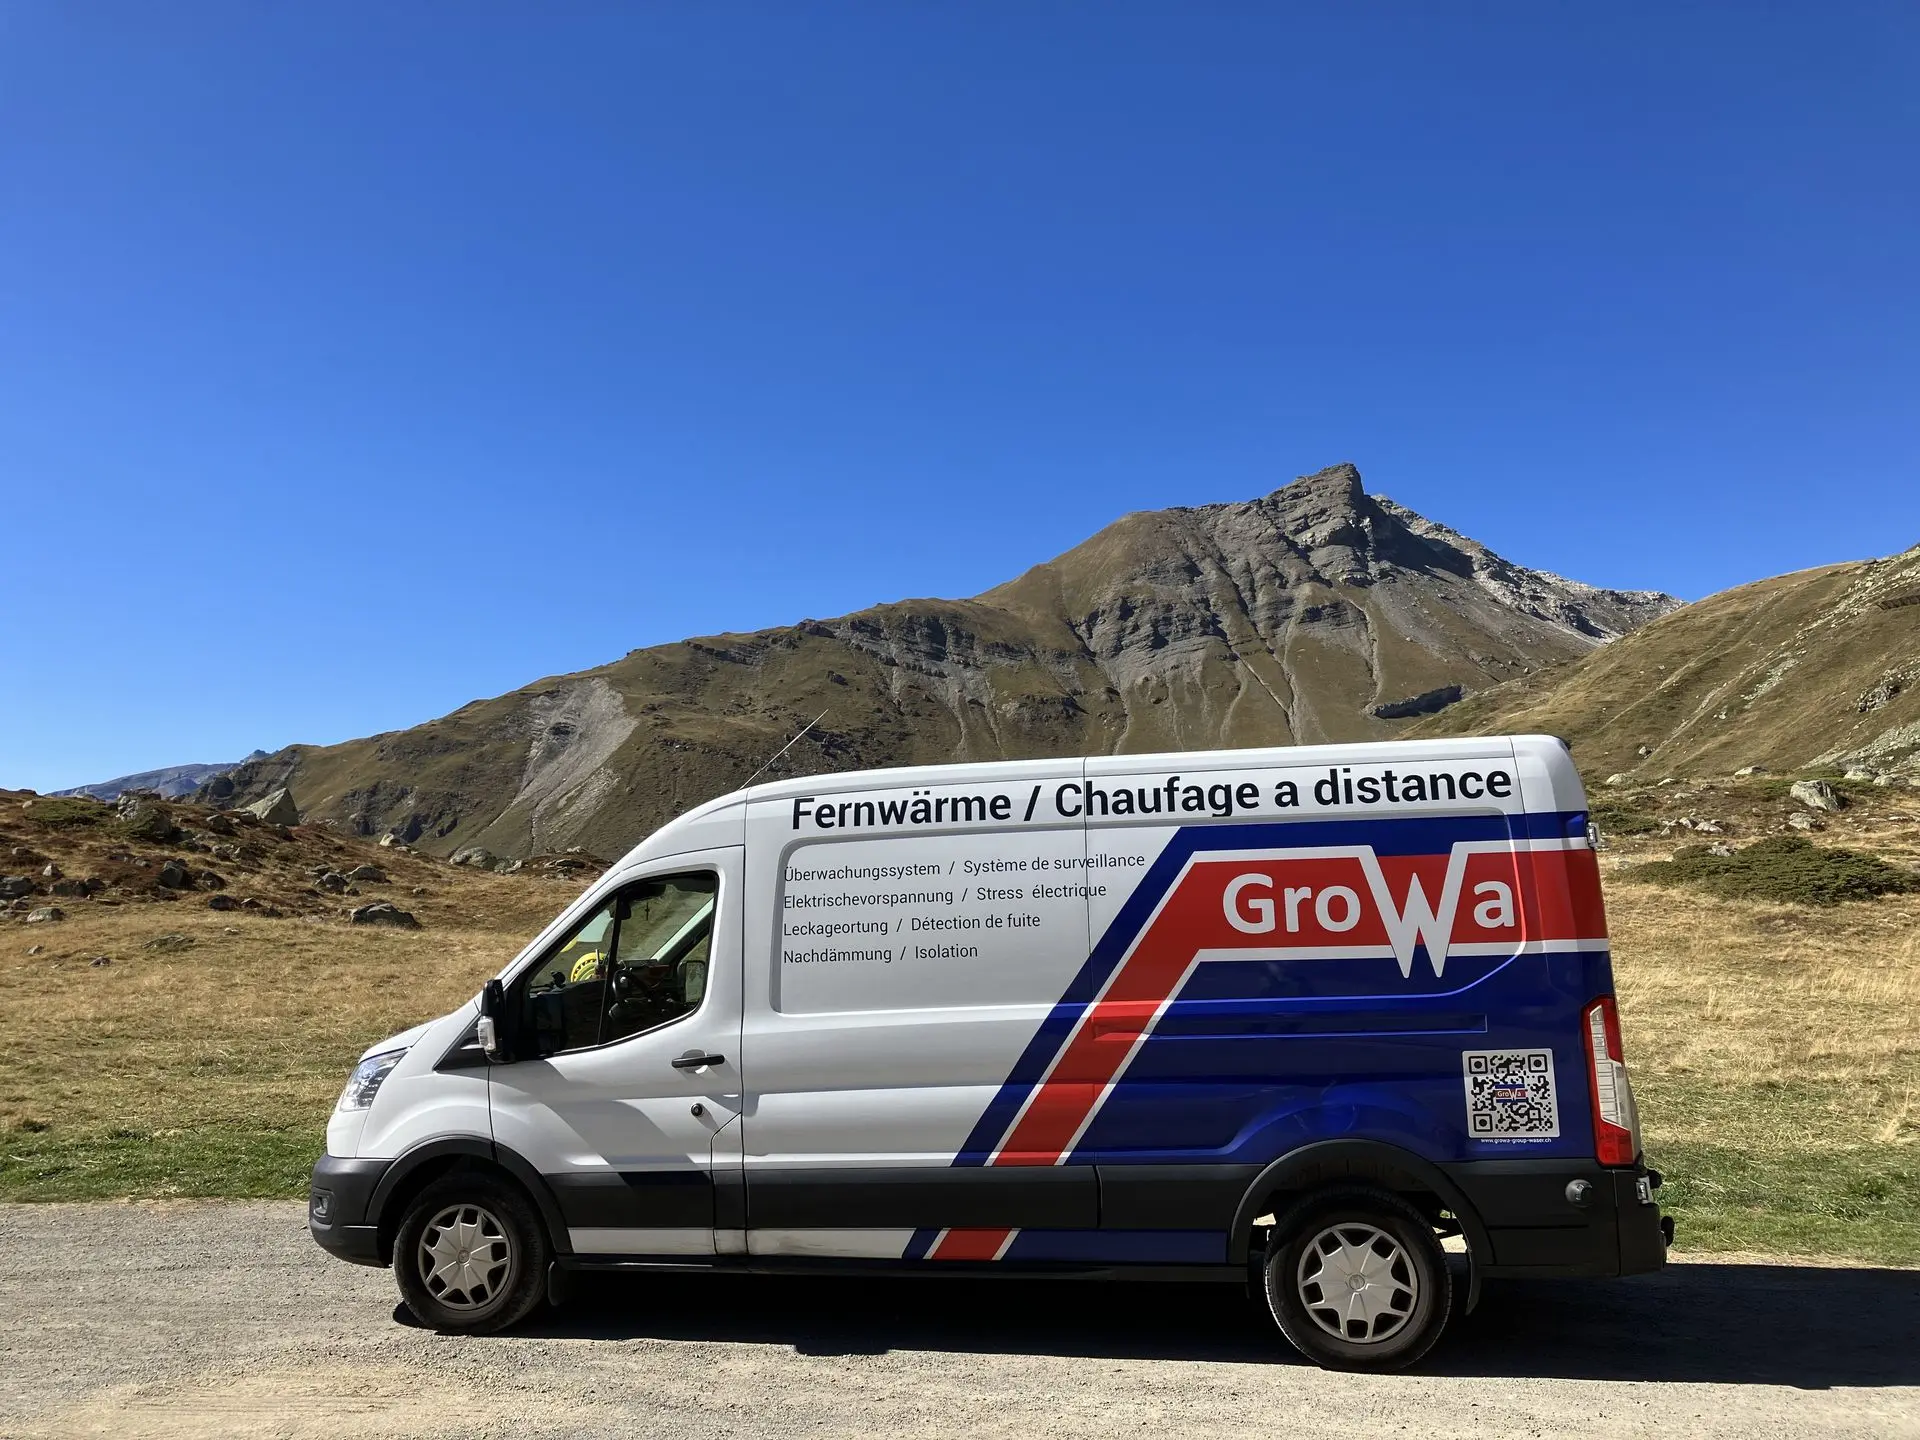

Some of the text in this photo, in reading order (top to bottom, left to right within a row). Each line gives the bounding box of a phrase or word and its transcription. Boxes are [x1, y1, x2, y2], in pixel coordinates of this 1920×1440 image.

[792, 768, 1512, 829] Fernwärme / Chaufage a distance
[784, 861, 941, 883] Überwachungssystem
[964, 858, 1027, 876] Système
[1032, 856, 1049, 872] de
[1054, 853, 1145, 870] surveillance
[784, 888, 953, 909] Elektrischevorspannung
[977, 886, 1023, 902] Stress
[1032, 883, 1107, 901] électrique
[1222, 842, 1515, 978] GroWa
[784, 919, 888, 938] Leckageortung
[911, 915, 981, 931] Détection
[985, 914, 1003, 929] de
[1007, 912, 1041, 928] fuite
[784, 946, 892, 966] Nachdämmung
[915, 943, 978, 960] Isolation
